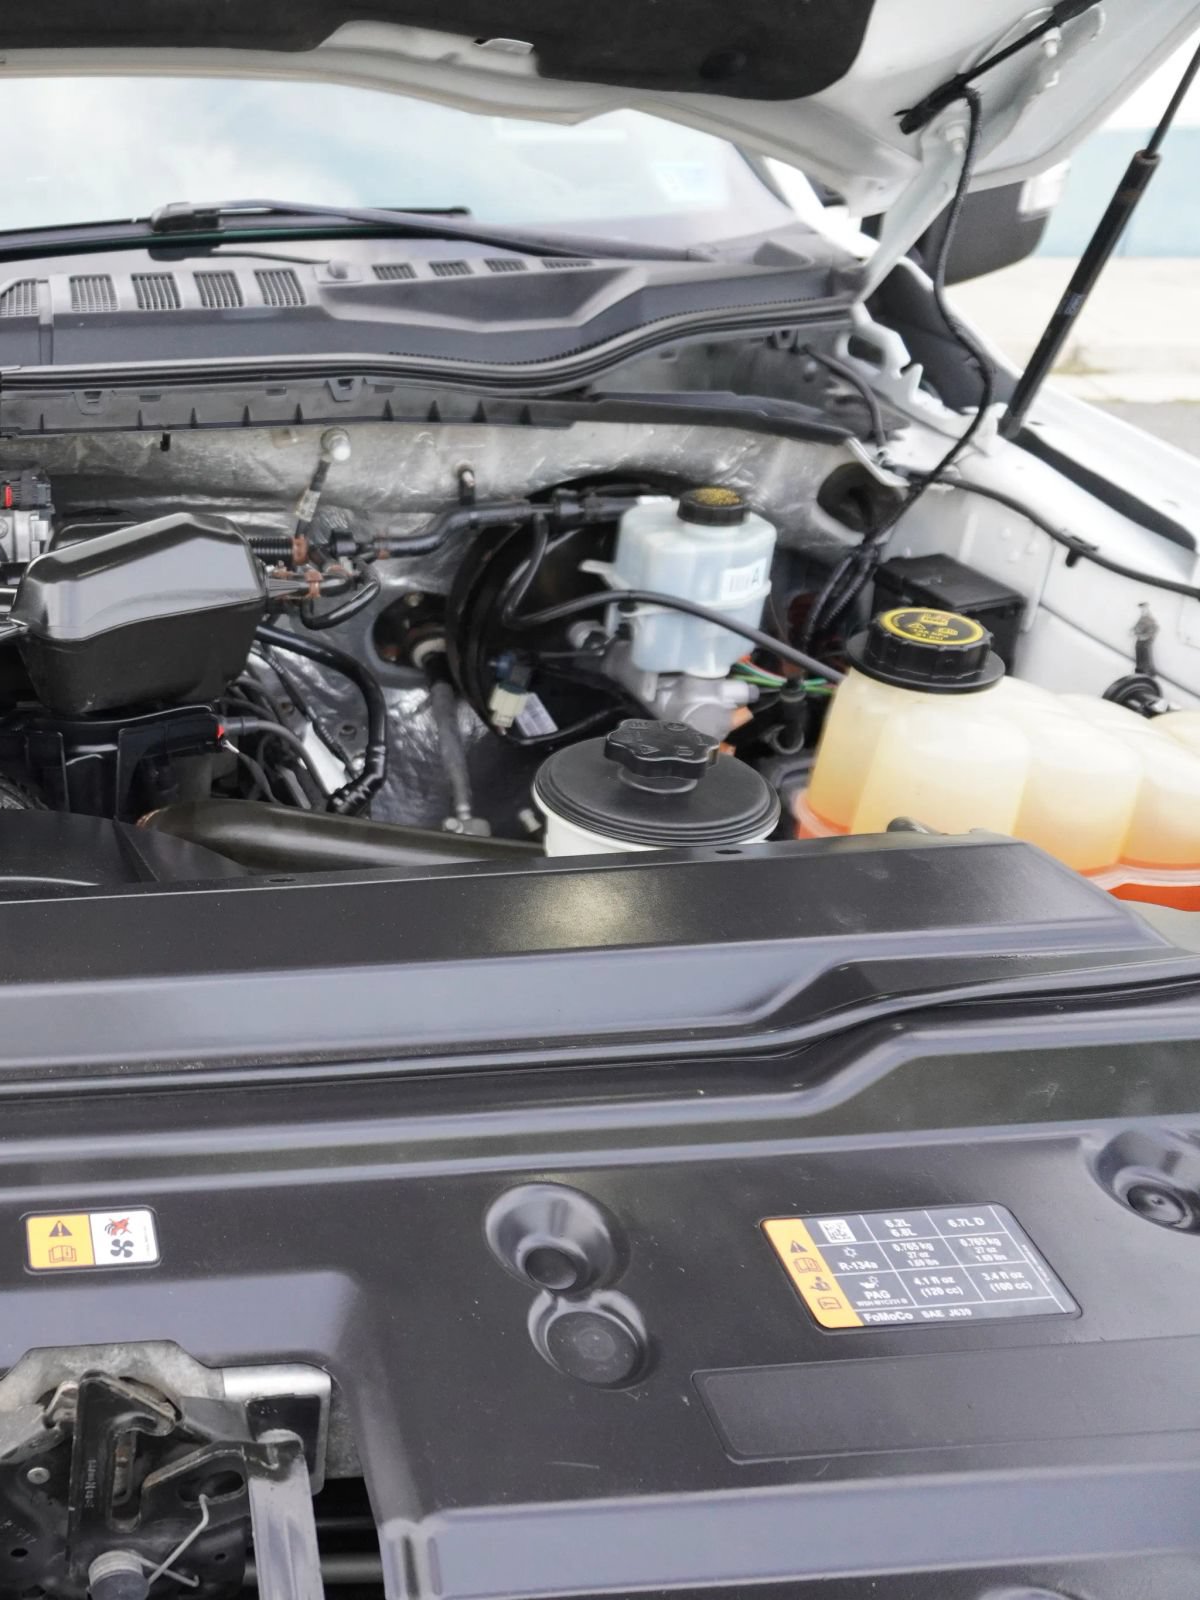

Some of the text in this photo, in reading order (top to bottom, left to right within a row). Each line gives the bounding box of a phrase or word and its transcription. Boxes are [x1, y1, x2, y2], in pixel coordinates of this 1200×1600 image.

[947, 1217, 985, 1228] 6.7L D
[985, 1237, 1002, 1246] kg
[918, 1242, 934, 1251] kg
[838, 1261, 879, 1271] R-134a
[981, 1272, 1000, 1280] 3.4
[914, 1277, 930, 1285] 4.1
[863, 1290, 891, 1300] PAG
[863, 1311, 914, 1322] FoMoCo
